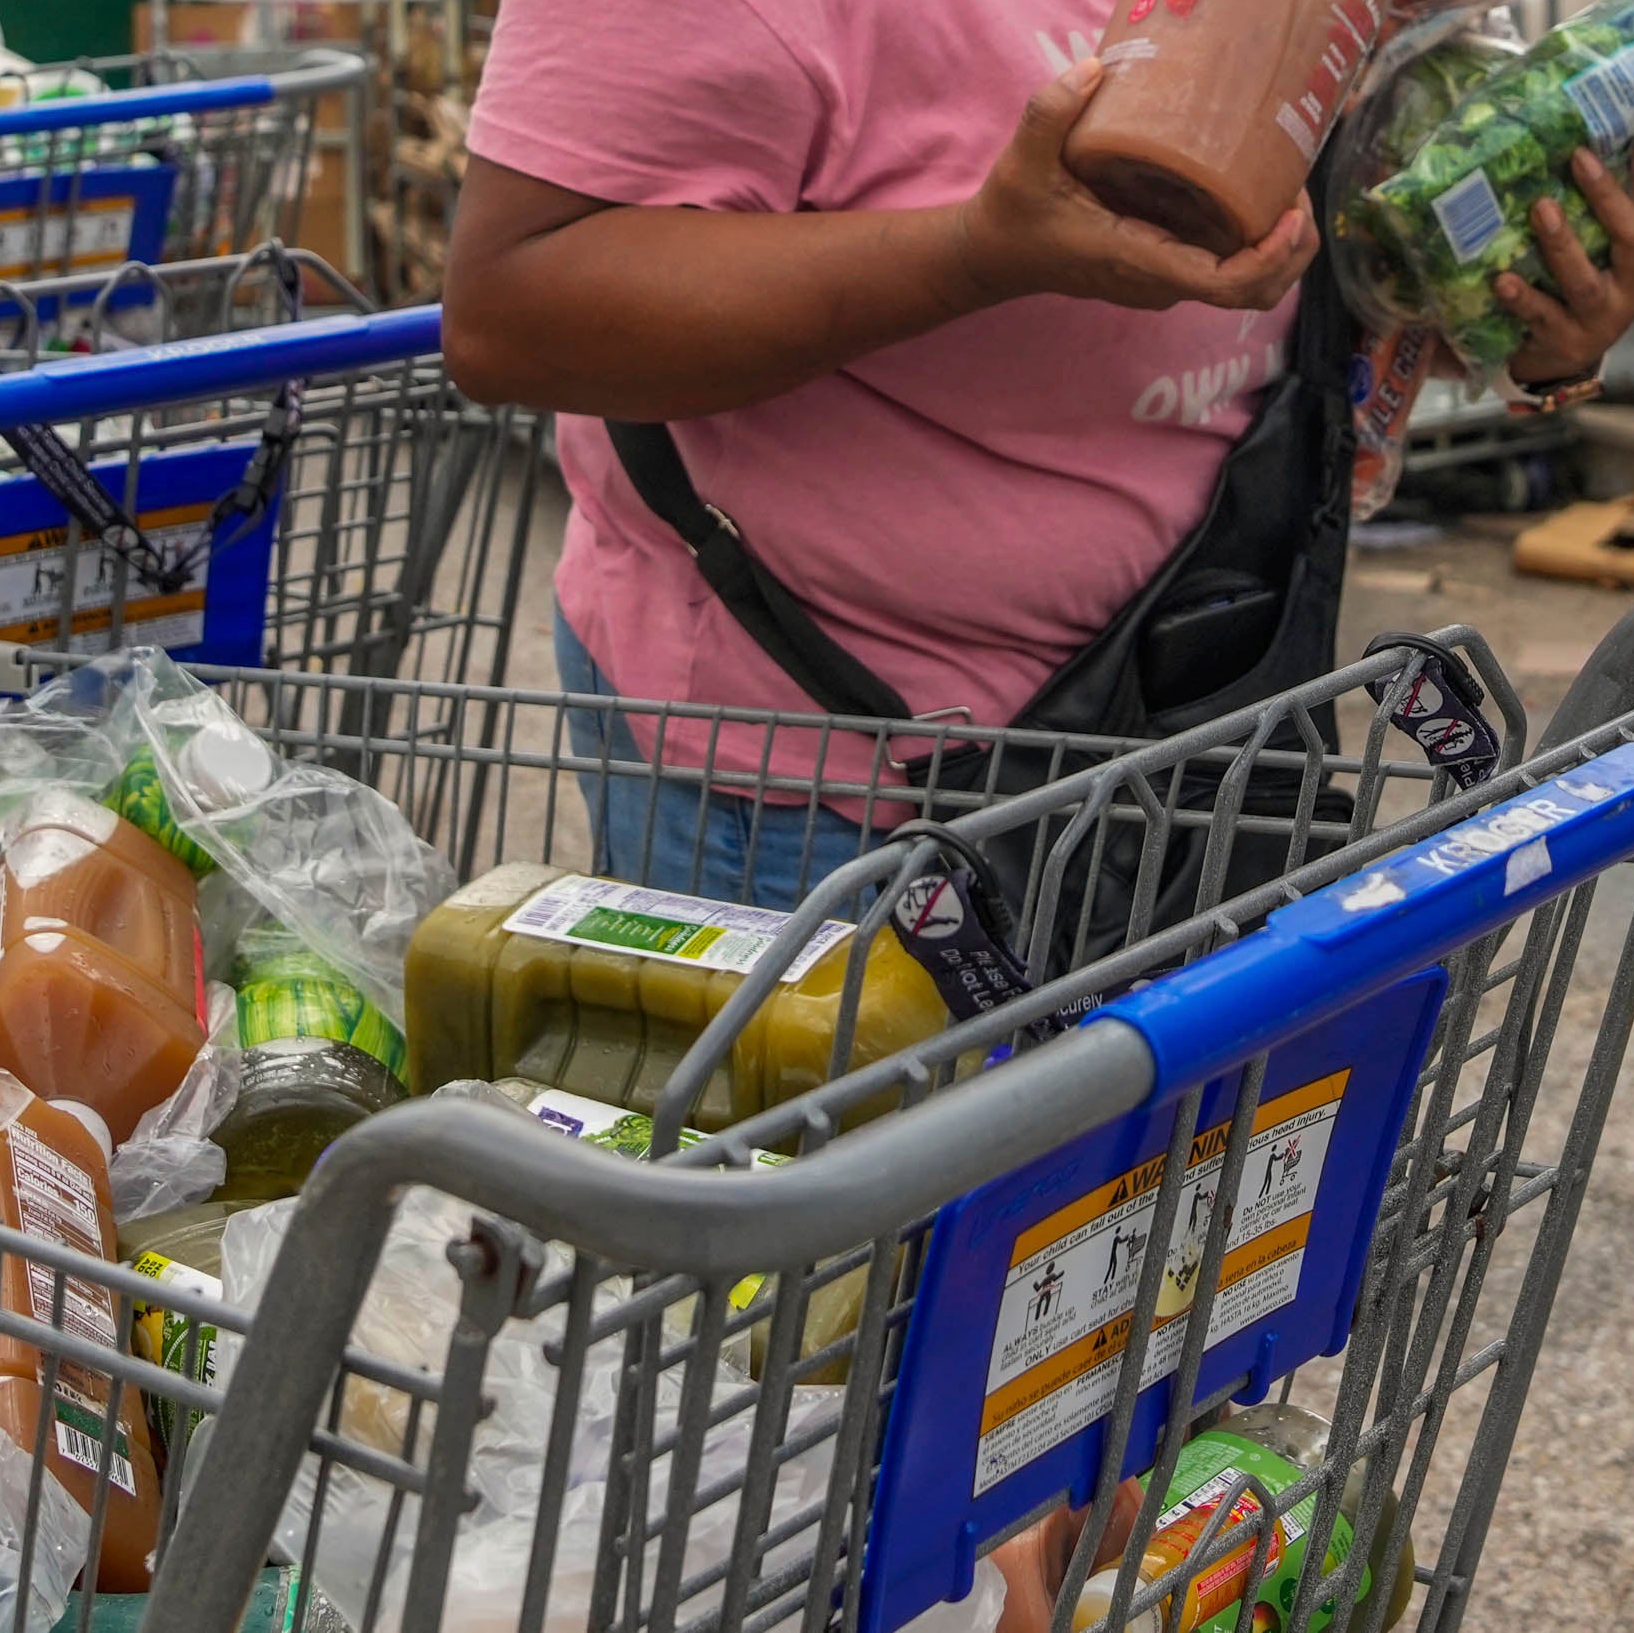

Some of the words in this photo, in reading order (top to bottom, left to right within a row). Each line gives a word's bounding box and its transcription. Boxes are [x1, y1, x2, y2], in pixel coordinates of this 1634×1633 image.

[1131, 353, 1251, 426] OWN
[1056, 992, 1104, 1017] curely
[1131, 1128, 1230, 1194] WANIN
[1017, 1256, 1041, 1274] Your
[1042, 1239, 1068, 1260] child
[1068, 1228, 1088, 1244] can
[1089, 1216, 1106, 1233] fall
[1106, 1206, 1124, 1223] out
[1125, 1199, 1137, 1213] of
[1138, 1191, 1155, 1206] the
[1181, 1168, 1196, 1183] nd
[1249, 1132, 1270, 1149] ious
[1271, 1119, 1296, 1139] head
[1295, 1105, 1328, 1129] injury.
[1241, 1205, 1253, 1216] Do
[1254, 1195, 1271, 1209] NOT
[1271, 1189, 1285, 1200] use
[74, 1201, 96, 1223] 150
[1024, 1346, 1050, 1366] ONLY
[1069, 1324, 1087, 1340] cart
[1088, 1313, 1106, 1329] seat
[1107, 1305, 1120, 1318] for
[1240, 1224, 1263, 1242] 15-35
[1091, 1283, 1114, 1300] STAY
[1221, 1287, 1233, 1298] NO
[1233, 1280, 1247, 1291] USE
[1041, 1370, 1071, 1393] puede
[1093, 1346, 1107, 1361] de
[1107, 1341, 1117, 1353] el
[1245, 1260, 1257, 1272] en
[1256, 1252, 1267, 1265] la
[1265, 1237, 1298, 1261] cabeza
[1155, 1326, 1167, 1337] NO
[1167, 1313, 1190, 1330] PERM
[1002, 1327, 1038, 1351] ALWAYS
